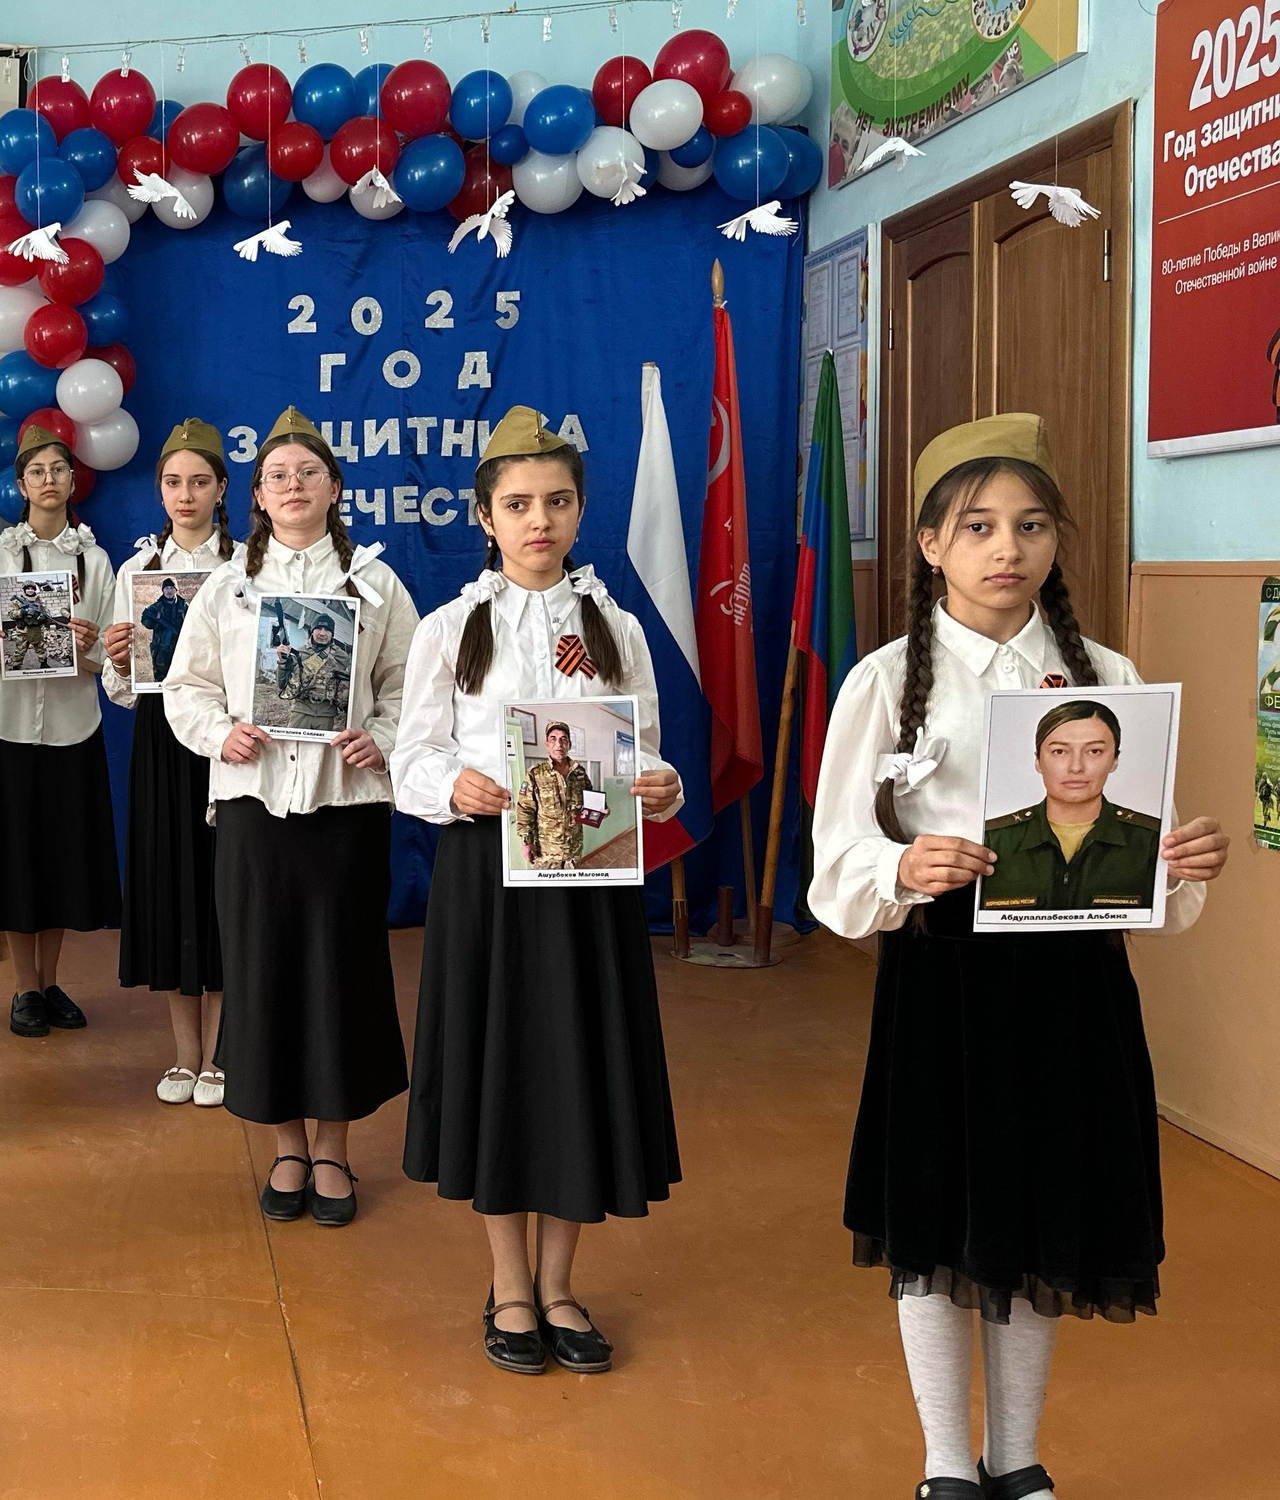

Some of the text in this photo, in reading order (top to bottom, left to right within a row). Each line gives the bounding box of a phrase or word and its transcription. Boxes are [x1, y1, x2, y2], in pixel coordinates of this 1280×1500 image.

[1189, 0, 1280, 111] 2025
[855, 73, 971, 137] НЕТ ЭКСТРЕМИЗМУ
[1163, 129, 1197, 164] Год
[1184, 139, 1280, 197] Отечества
[1162, 252, 1202, 276] 80-летие
[1204, 241, 1241, 265] Победы
[1244, 238, 1250, 252] в
[1175, 254, 1278, 296] Отечественной войне
[320, 349, 492, 392] ГОД
[227, 414, 589, 464] ЗЩИТНА
